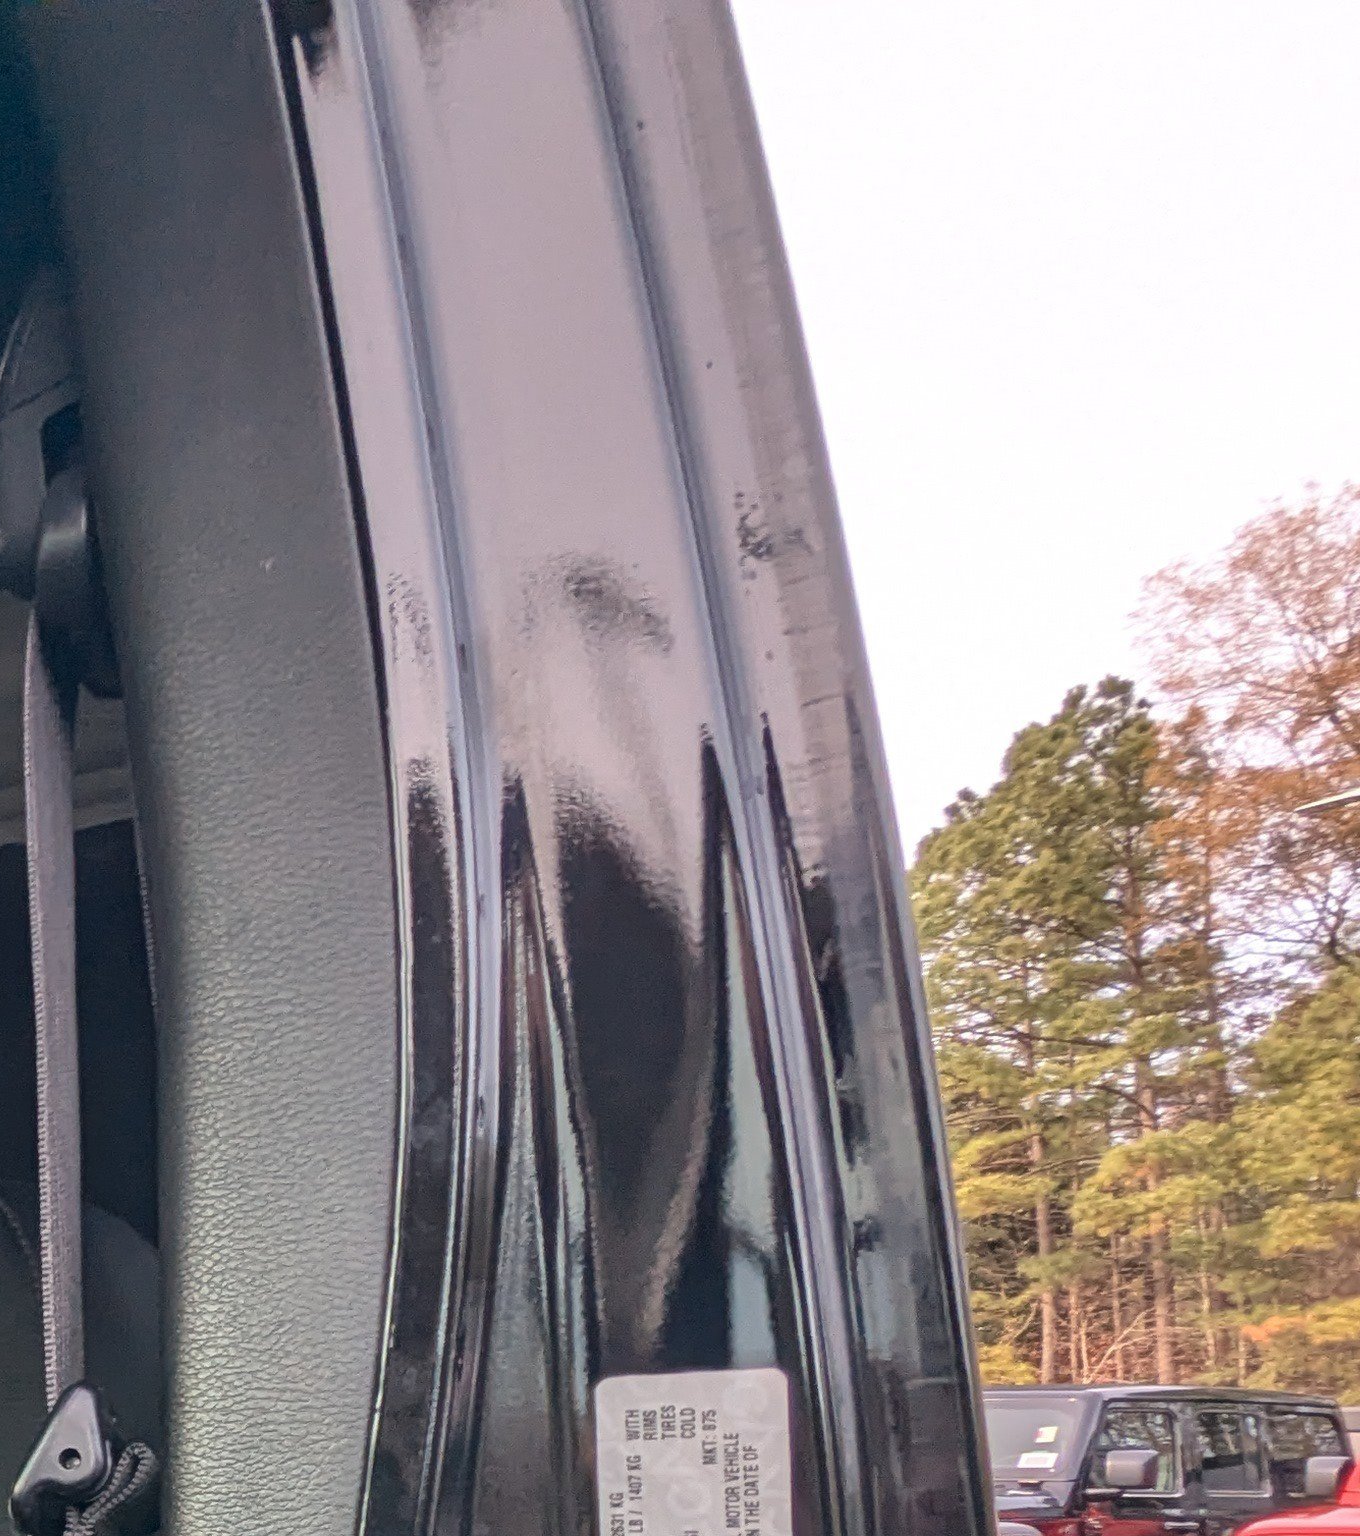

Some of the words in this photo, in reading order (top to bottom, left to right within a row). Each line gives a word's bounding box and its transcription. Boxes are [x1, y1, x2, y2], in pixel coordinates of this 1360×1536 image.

[625, 1409, 640, 1441] WITH
[643, 1409, 658, 1441] RIMS
[661, 1405, 676, 1440] TIRES
[680, 1407, 696, 1439] COLD
[626, 1455, 641, 1471] KG
[702, 1436, 718, 1465] MKT:
[723, 1433, 740, 1482] VEHICLE
[742, 1445, 759, 1461] OF
[627, 1475, 642, 1501] 1407
[743, 1465, 759, 1496] DATE
[609, 1493, 624, 1508] KG
[725, 1486, 741, 1528] MOTOR
[744, 1502, 760, 1524] THE
[628, 1519, 643, 1533] LB
